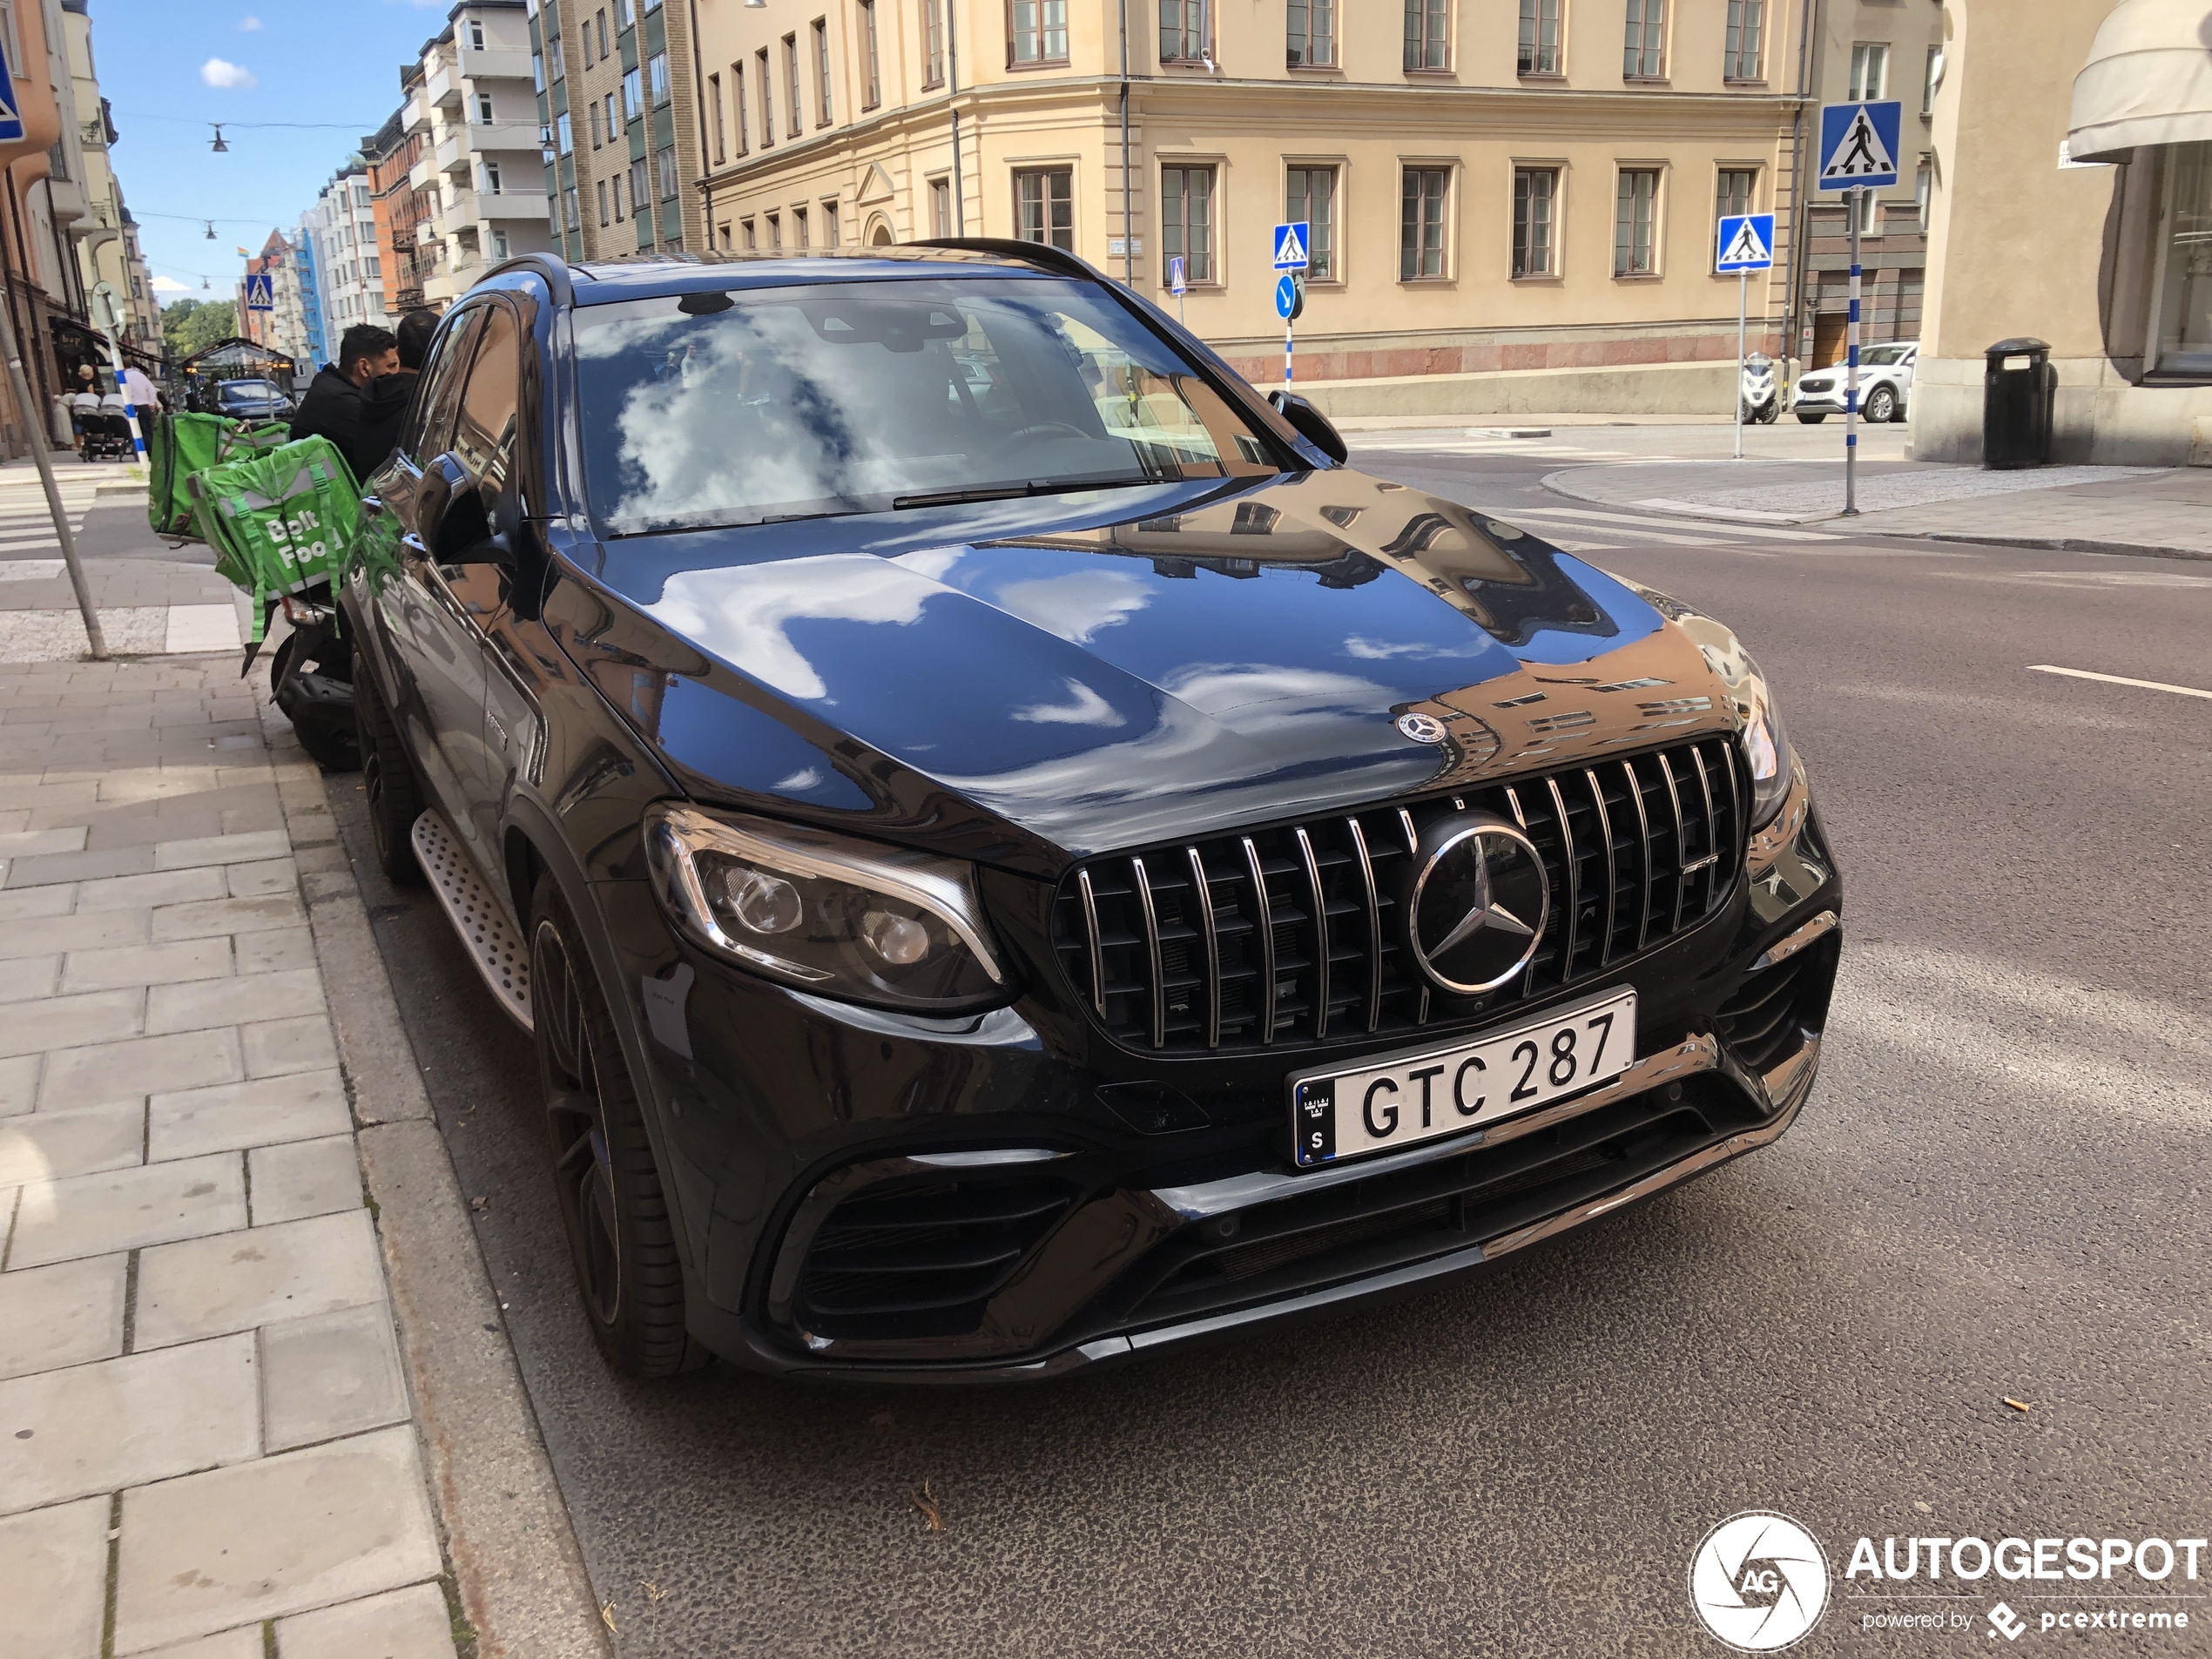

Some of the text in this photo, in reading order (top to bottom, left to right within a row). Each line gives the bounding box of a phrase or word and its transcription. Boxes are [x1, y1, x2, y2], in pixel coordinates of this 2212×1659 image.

[265, 509, 320, 543] Bolt
[278, 527, 345, 570] Food
[1362, 1011, 1615, 1139] GTC 287
[1311, 1131, 1323, 1149] S
